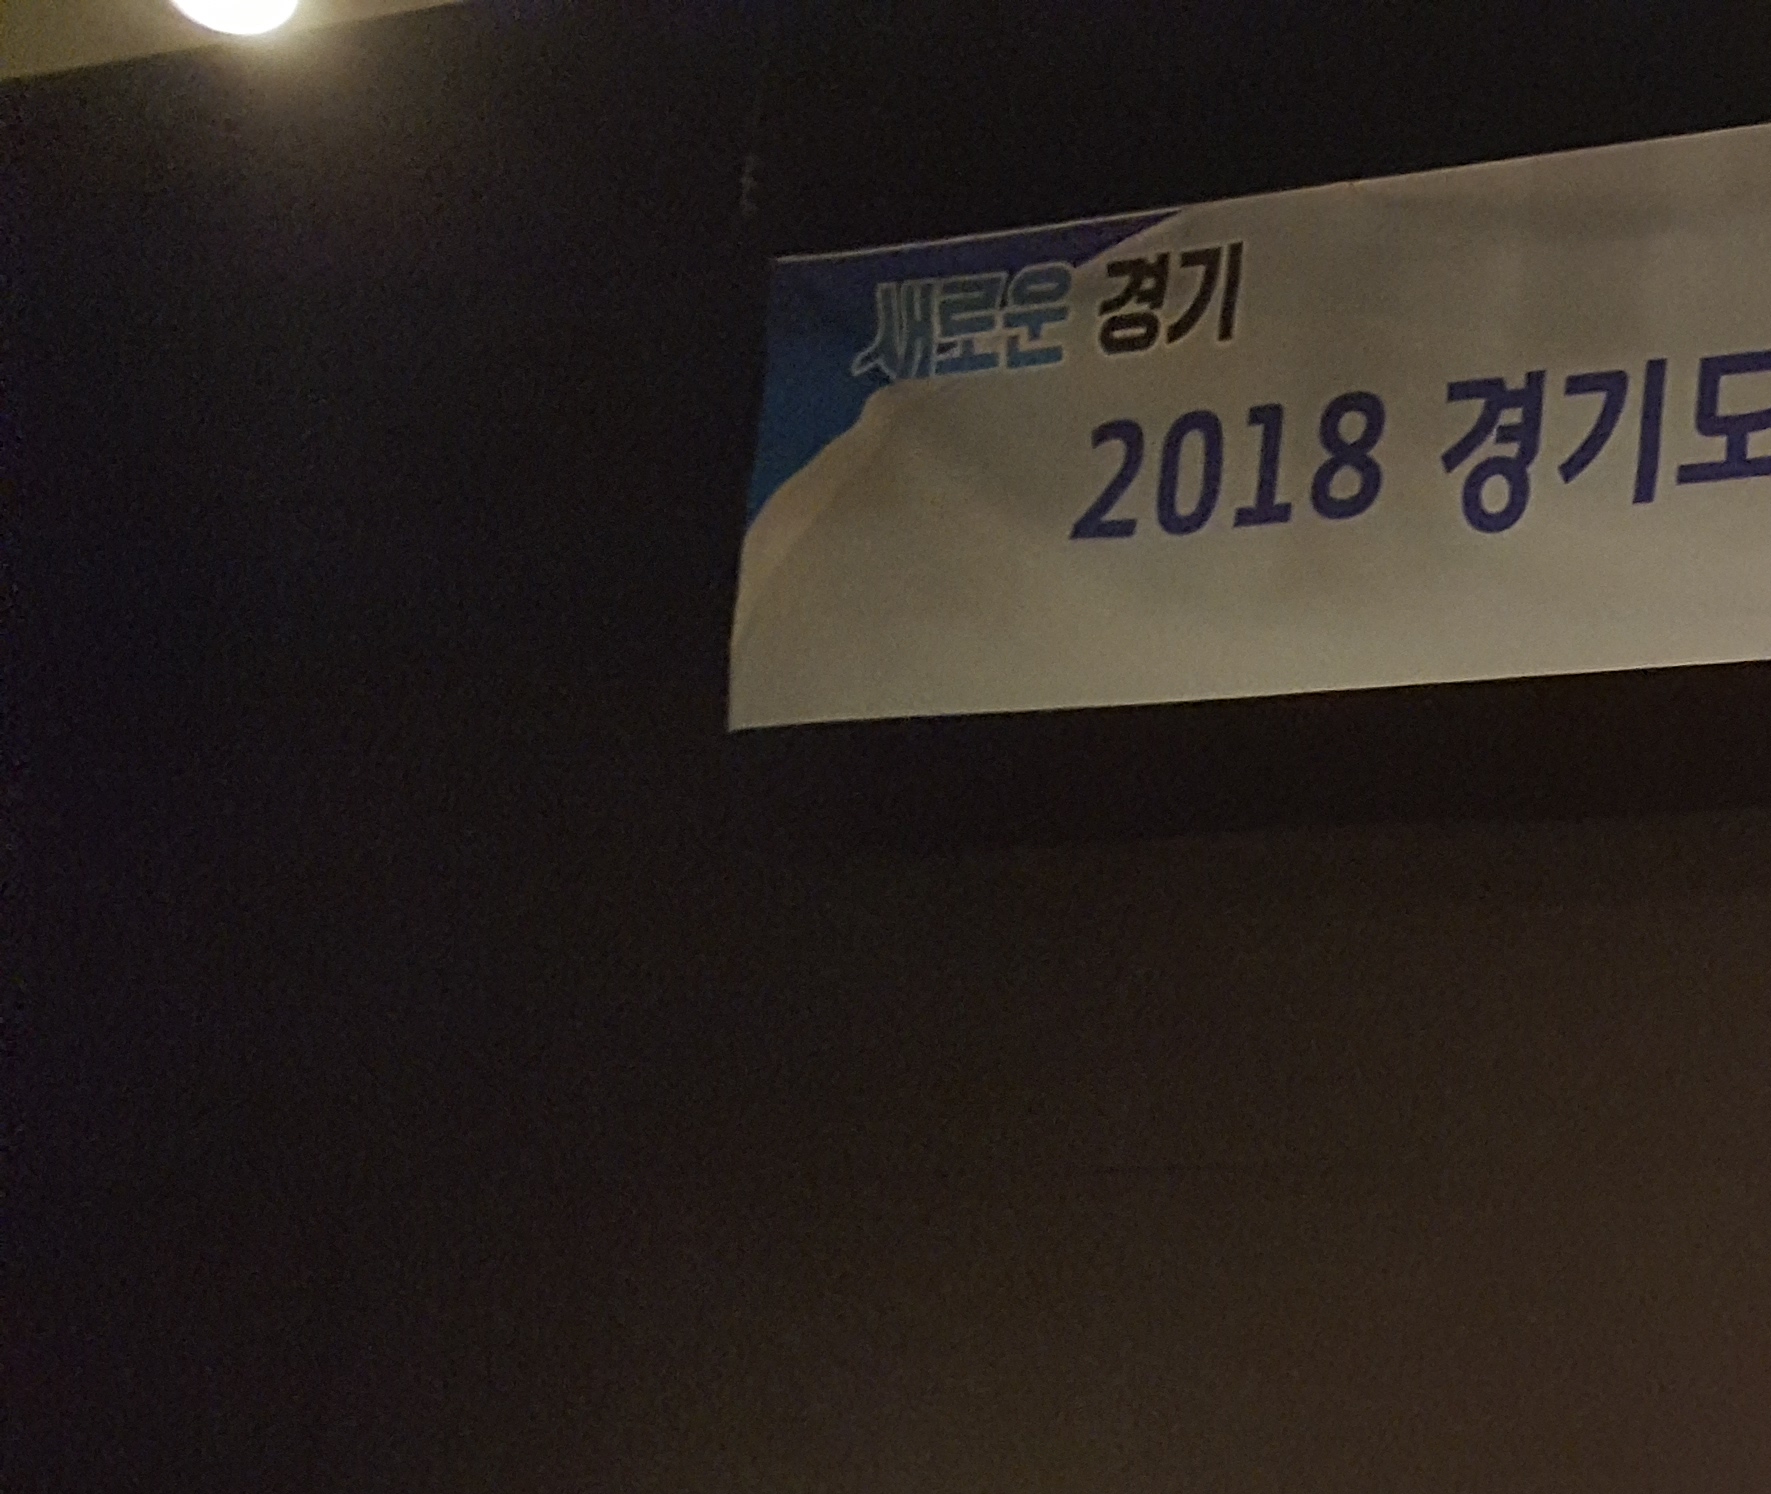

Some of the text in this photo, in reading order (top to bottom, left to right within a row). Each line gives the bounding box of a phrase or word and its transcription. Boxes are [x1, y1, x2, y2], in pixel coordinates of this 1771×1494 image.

[851, 240, 1244, 380] 새로운 경기
[1070, 391, 1385, 539] 2018
